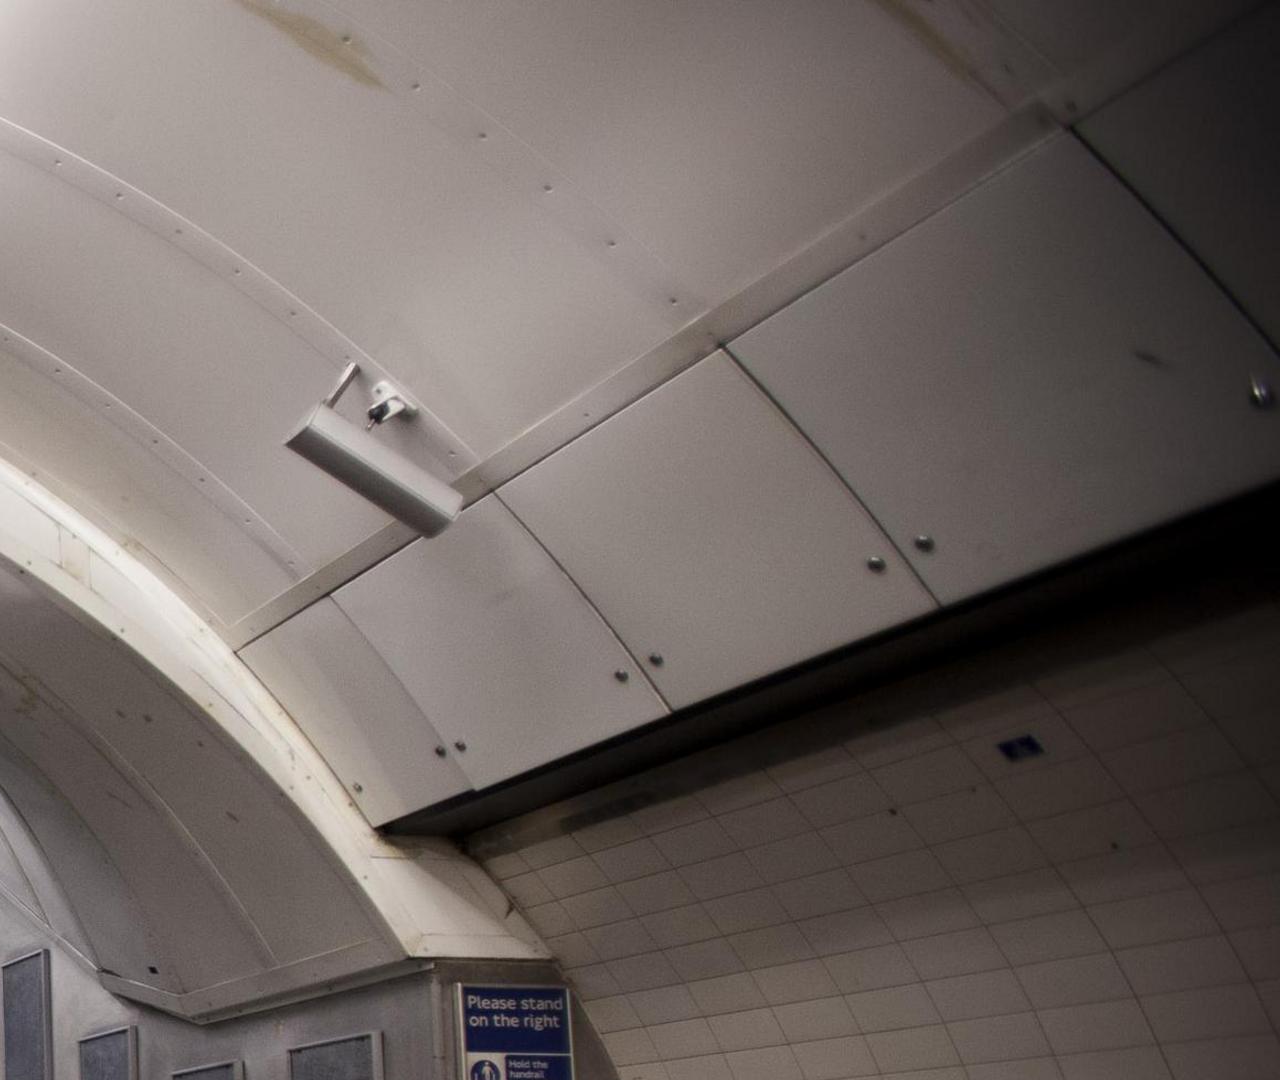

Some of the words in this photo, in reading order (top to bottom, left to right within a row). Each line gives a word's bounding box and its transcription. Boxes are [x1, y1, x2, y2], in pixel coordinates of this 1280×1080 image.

[467, 995, 517, 1010] Please
[521, 998, 563, 1010] stand
[469, 1016, 488, 1027] on
[493, 1014, 519, 1027] the
[524, 1015, 560, 1031] right
[508, 1060, 530, 1069] Hold
[533, 1061, 548, 1069] the
[509, 1071, 544, 1079] handrail
